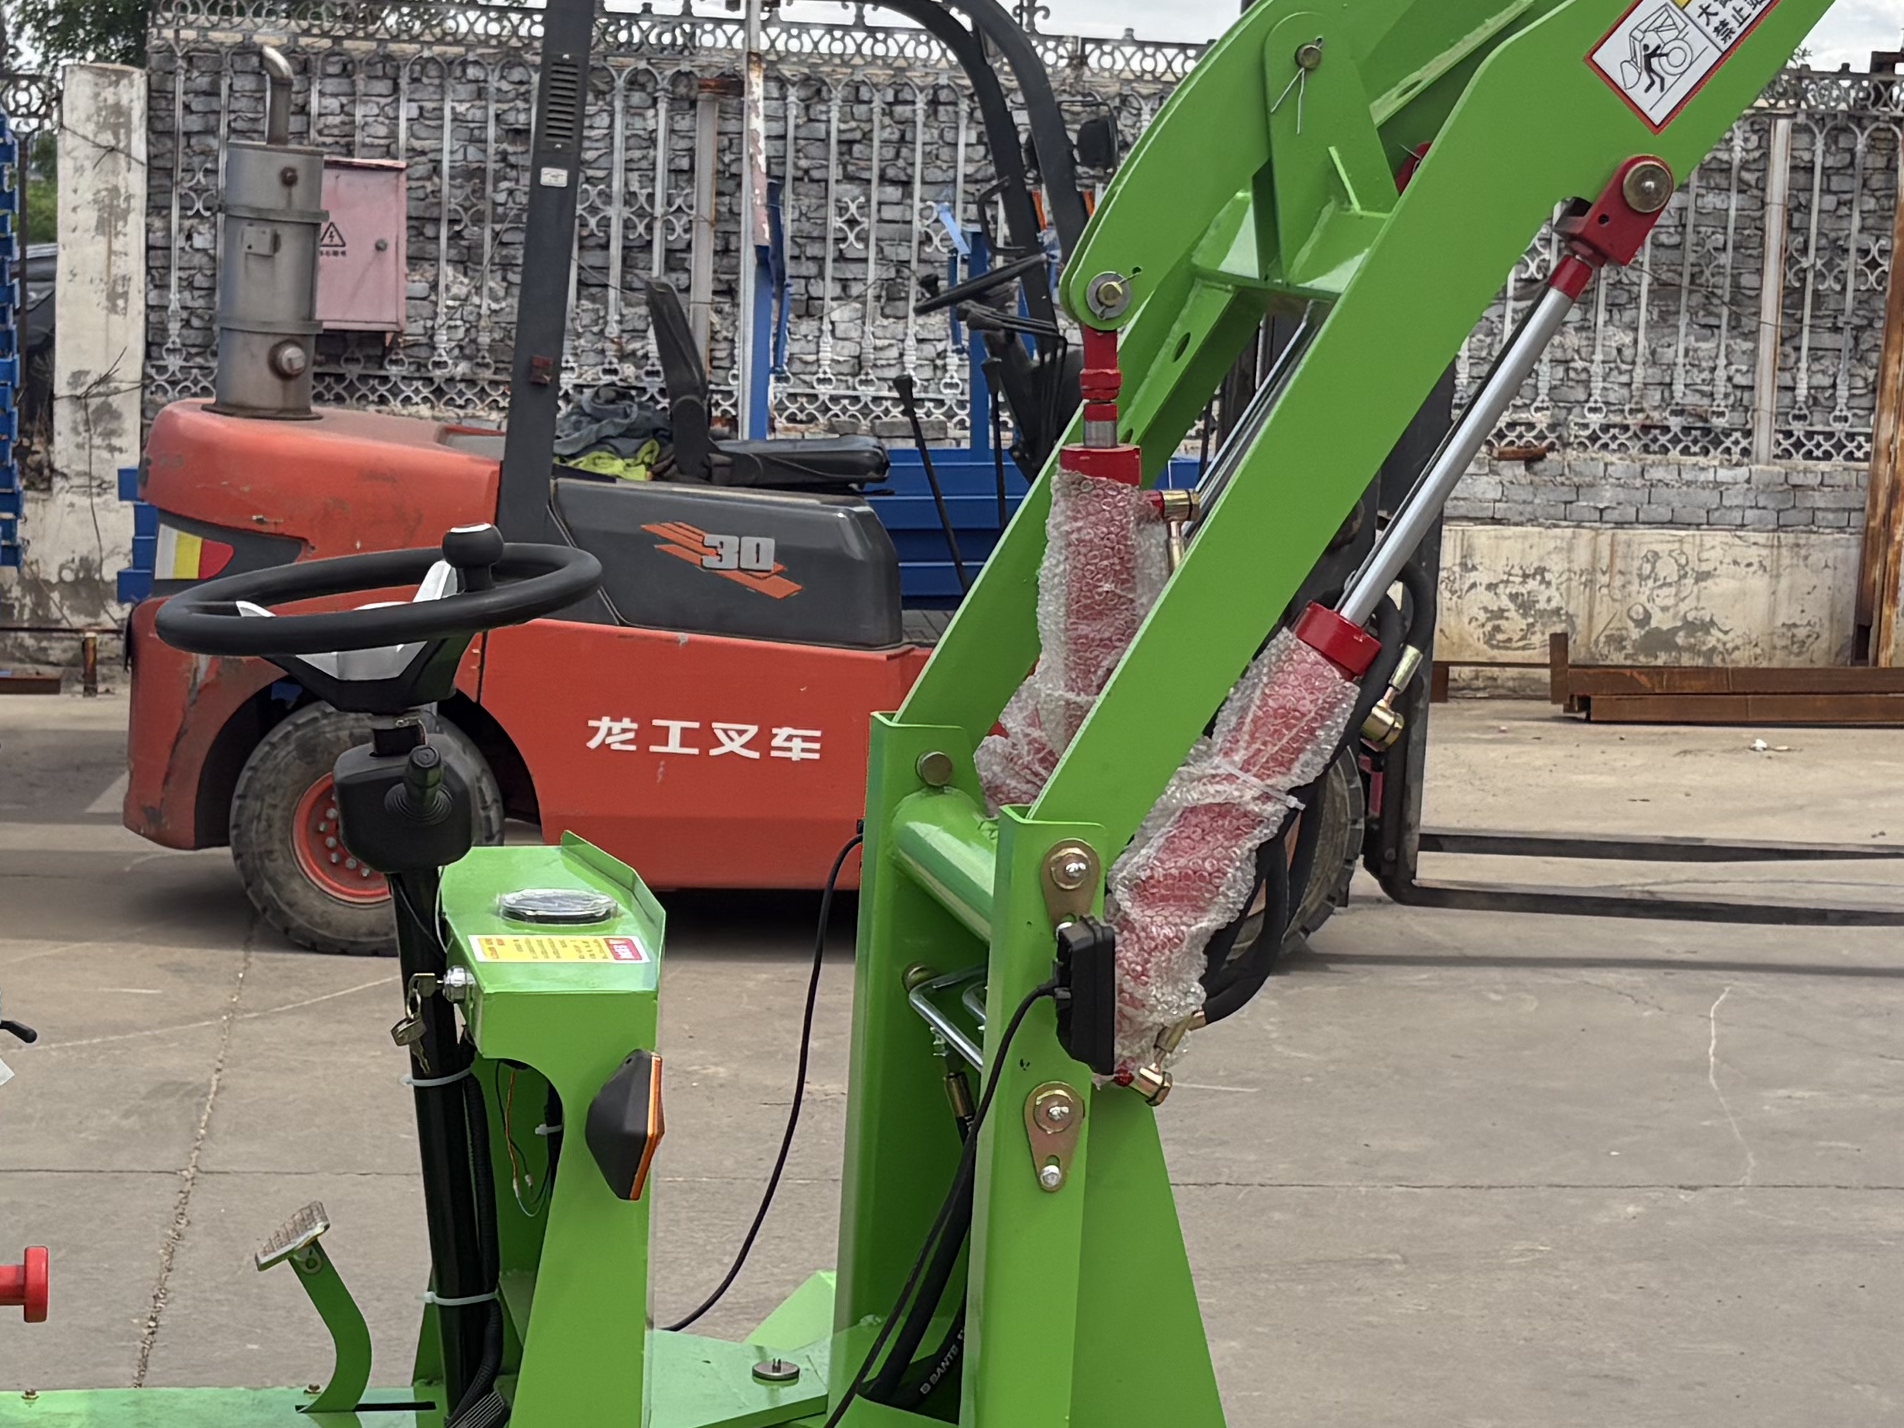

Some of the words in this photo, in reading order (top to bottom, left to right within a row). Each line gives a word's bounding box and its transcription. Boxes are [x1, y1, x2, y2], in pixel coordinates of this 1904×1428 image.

[701, 535, 776, 571] 30
[584, 716, 823, 762] 龙工叉车
